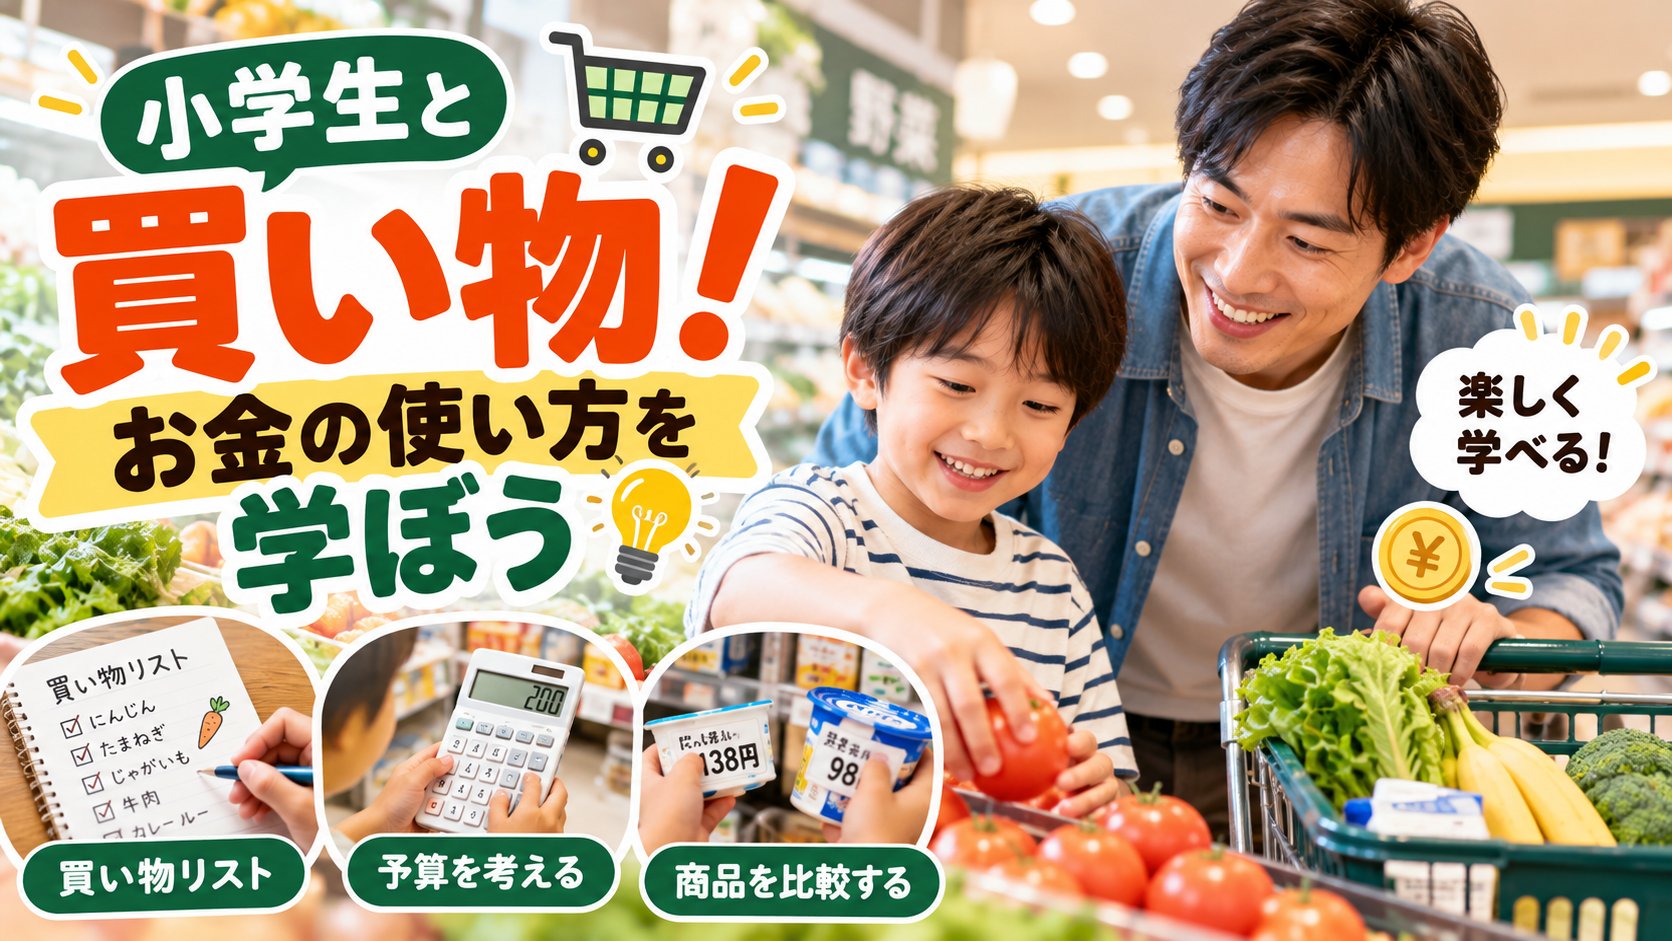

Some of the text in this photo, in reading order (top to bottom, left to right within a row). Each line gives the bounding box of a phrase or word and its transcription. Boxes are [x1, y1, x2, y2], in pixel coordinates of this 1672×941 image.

[46, 648, 188, 705] 買い物リスト
[90, 699, 156, 729] にんじん
[523, 684, 566, 716] 200
[100, 723, 165, 757] たまねぎ
[111, 750, 190, 785] じゃがいも
[699, 742, 760, 777] 138円
[827, 756, 861, 789] 98
[122, 790, 161, 813] 牛肉
[132, 810, 208, 838] カレールー
